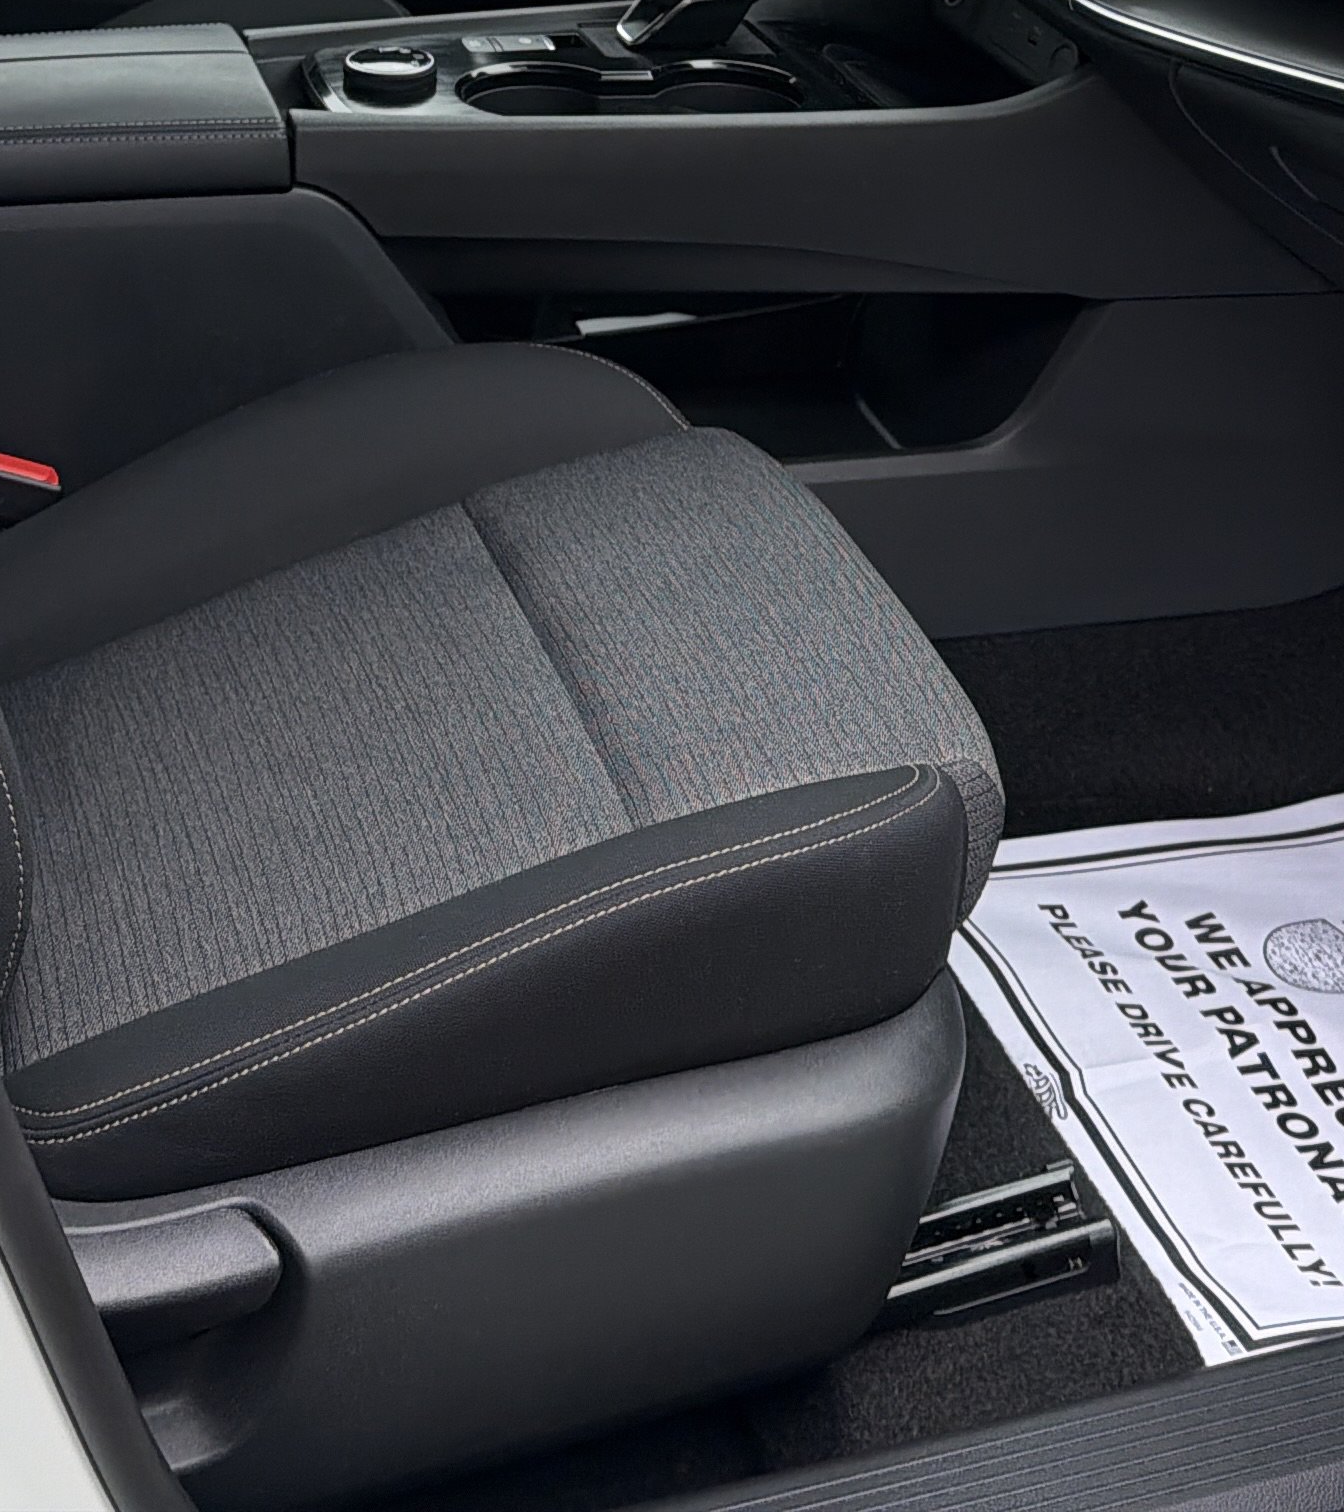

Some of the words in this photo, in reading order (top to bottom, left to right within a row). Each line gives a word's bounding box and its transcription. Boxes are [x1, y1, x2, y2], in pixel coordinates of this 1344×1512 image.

[1117, 899, 1219, 999] YOUR
[1185, 912, 1252, 970] WE
[1037, 904, 1133, 994] PLEASE
[1115, 1002, 1199, 1089] DRIVE
[1182, 1098, 1344, 1287] CAREFULLY!
